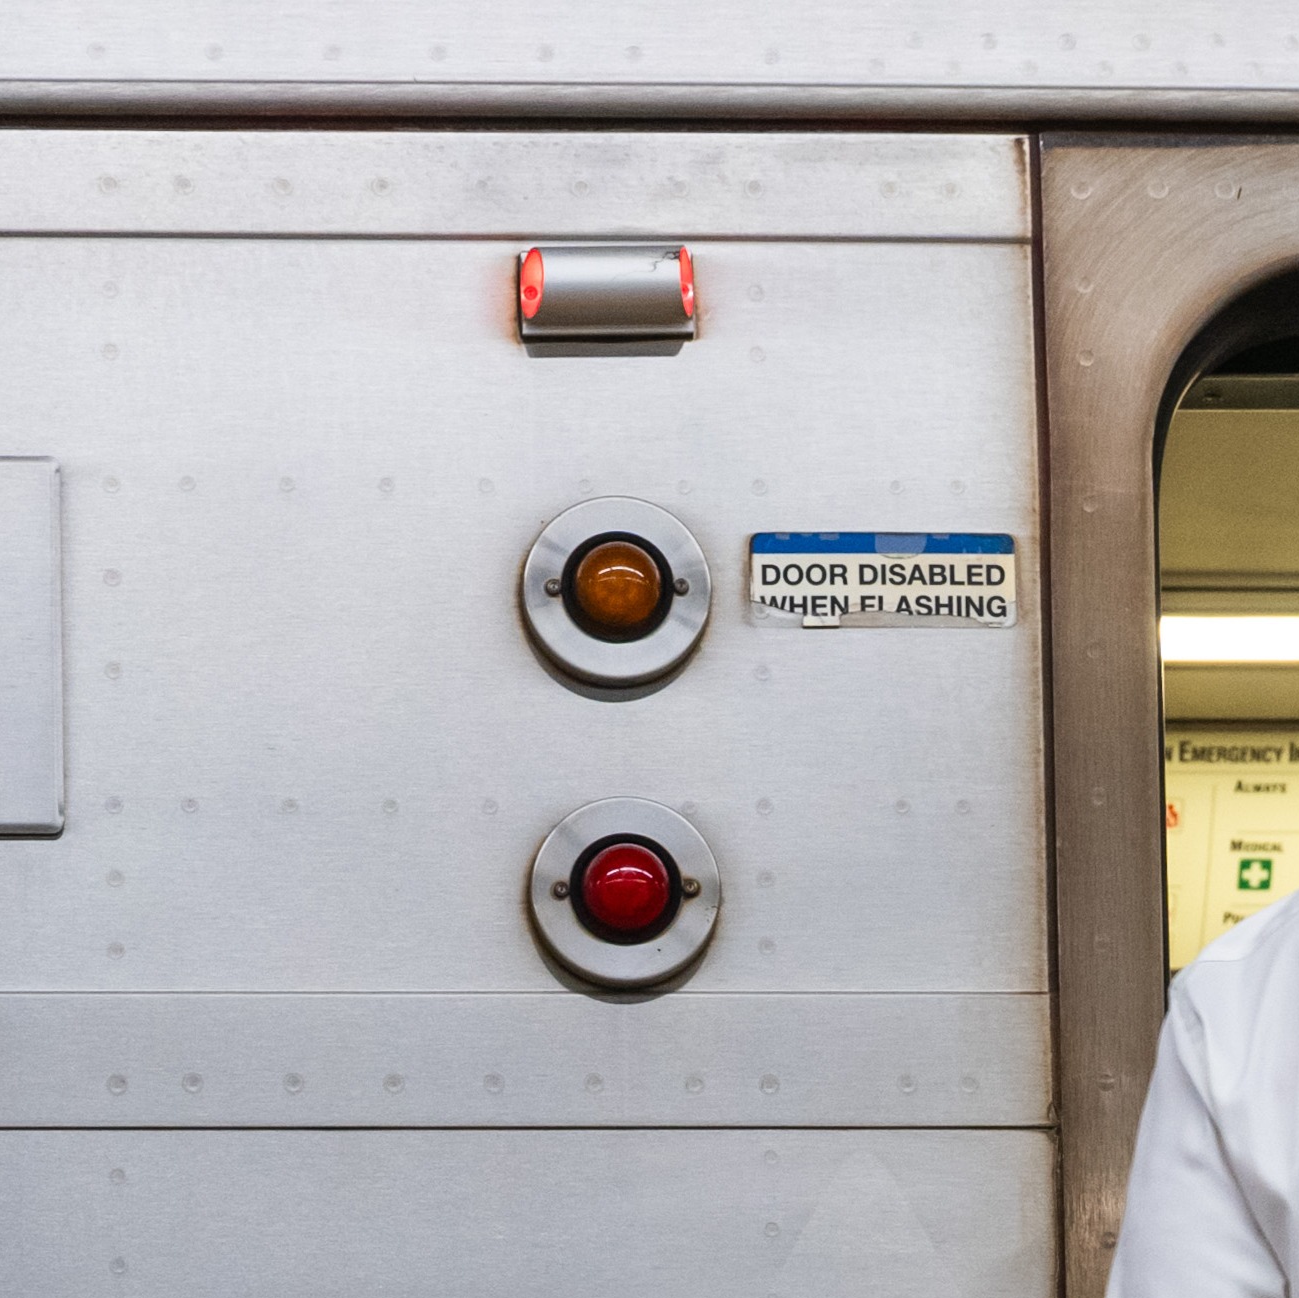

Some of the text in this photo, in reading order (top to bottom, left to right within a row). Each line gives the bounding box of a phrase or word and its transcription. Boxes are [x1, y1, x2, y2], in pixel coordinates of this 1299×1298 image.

[760, 563, 1007, 587] DOOR DISABLED
[759, 595, 850, 617] WHEN
[1178, 740, 1282, 763] EMERGENCY
[1229, 839, 1284, 852] MEDICAL
